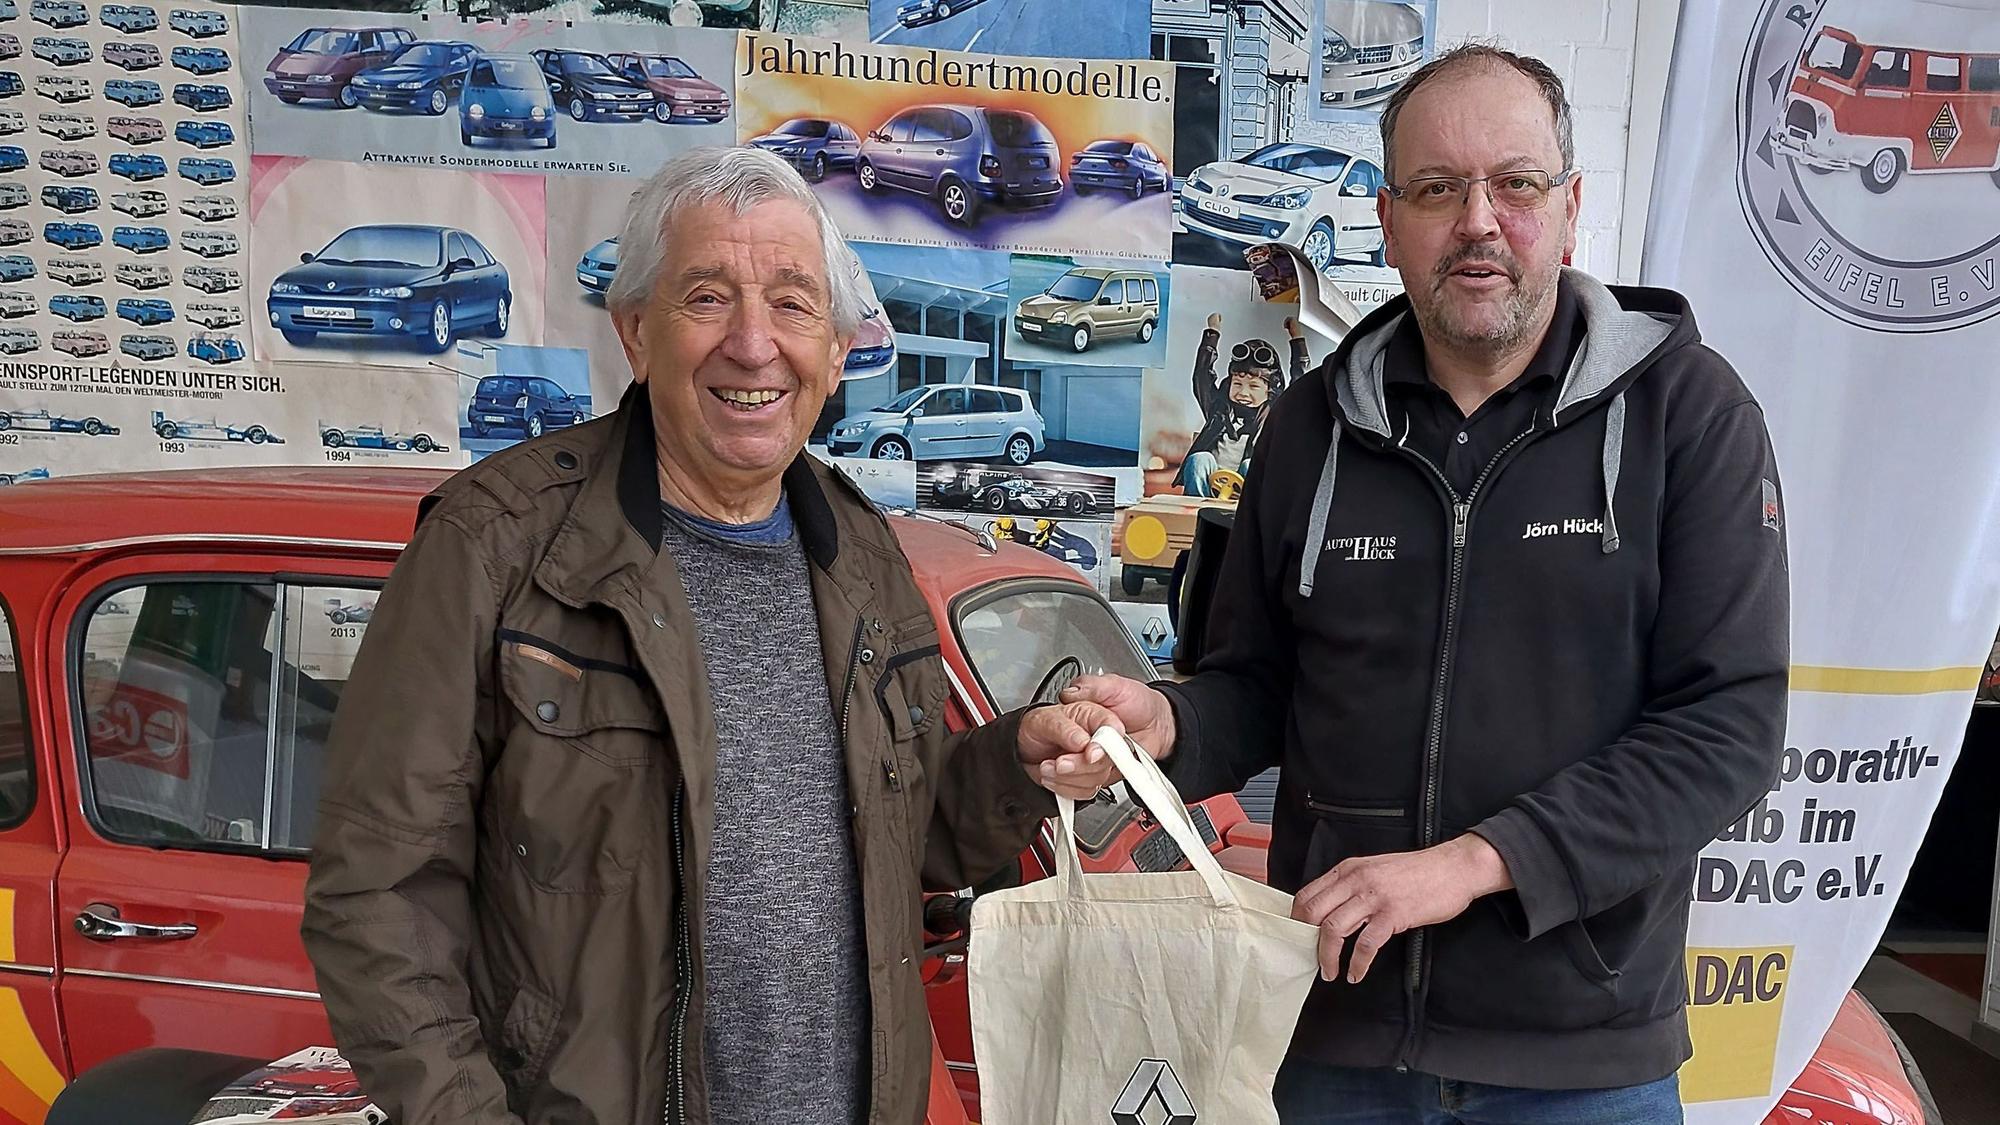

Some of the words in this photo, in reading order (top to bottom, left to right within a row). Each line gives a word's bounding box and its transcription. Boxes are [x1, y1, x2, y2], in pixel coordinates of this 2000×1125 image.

[741, 34, 1171, 103] Jahrhundertmodelle.
[362, 151, 435, 165] ATTRAKTIVE
[439, 155, 539, 169] SONDERMODELLE
[543, 161, 604, 172] ERWARTEN
[608, 162, 631, 173] SIE.
[1204, 201, 1231, 214] CLIO
[1804, 238, 1904, 308] EIFEL
[20, 381, 48, 391] STELLT
[50, 383, 67, 392] ZUM
[70, 384, 94, 393] 12TEN
[96, 385, 113, 395] MAL
[115, 386, 131, 395] DEN
[134, 387, 223, 400] WELTMEISTER-MOTOR!
[182, 371, 237, 390] UNTER
[242, 375, 285, 393] SICH.
[159, 441, 185, 453] 1993
[325, 450, 351, 461] 1994
[1522, 522, 1558, 539] Jörn
[1563, 518, 1603, 534] Hück
[330, 627, 356, 638] 2013
[1799, 798, 1856, 843] im
[1691, 857, 1805, 904] DAC
[1816, 854, 1885, 901] e.V.
[1686, 952, 1786, 1005] DAC
